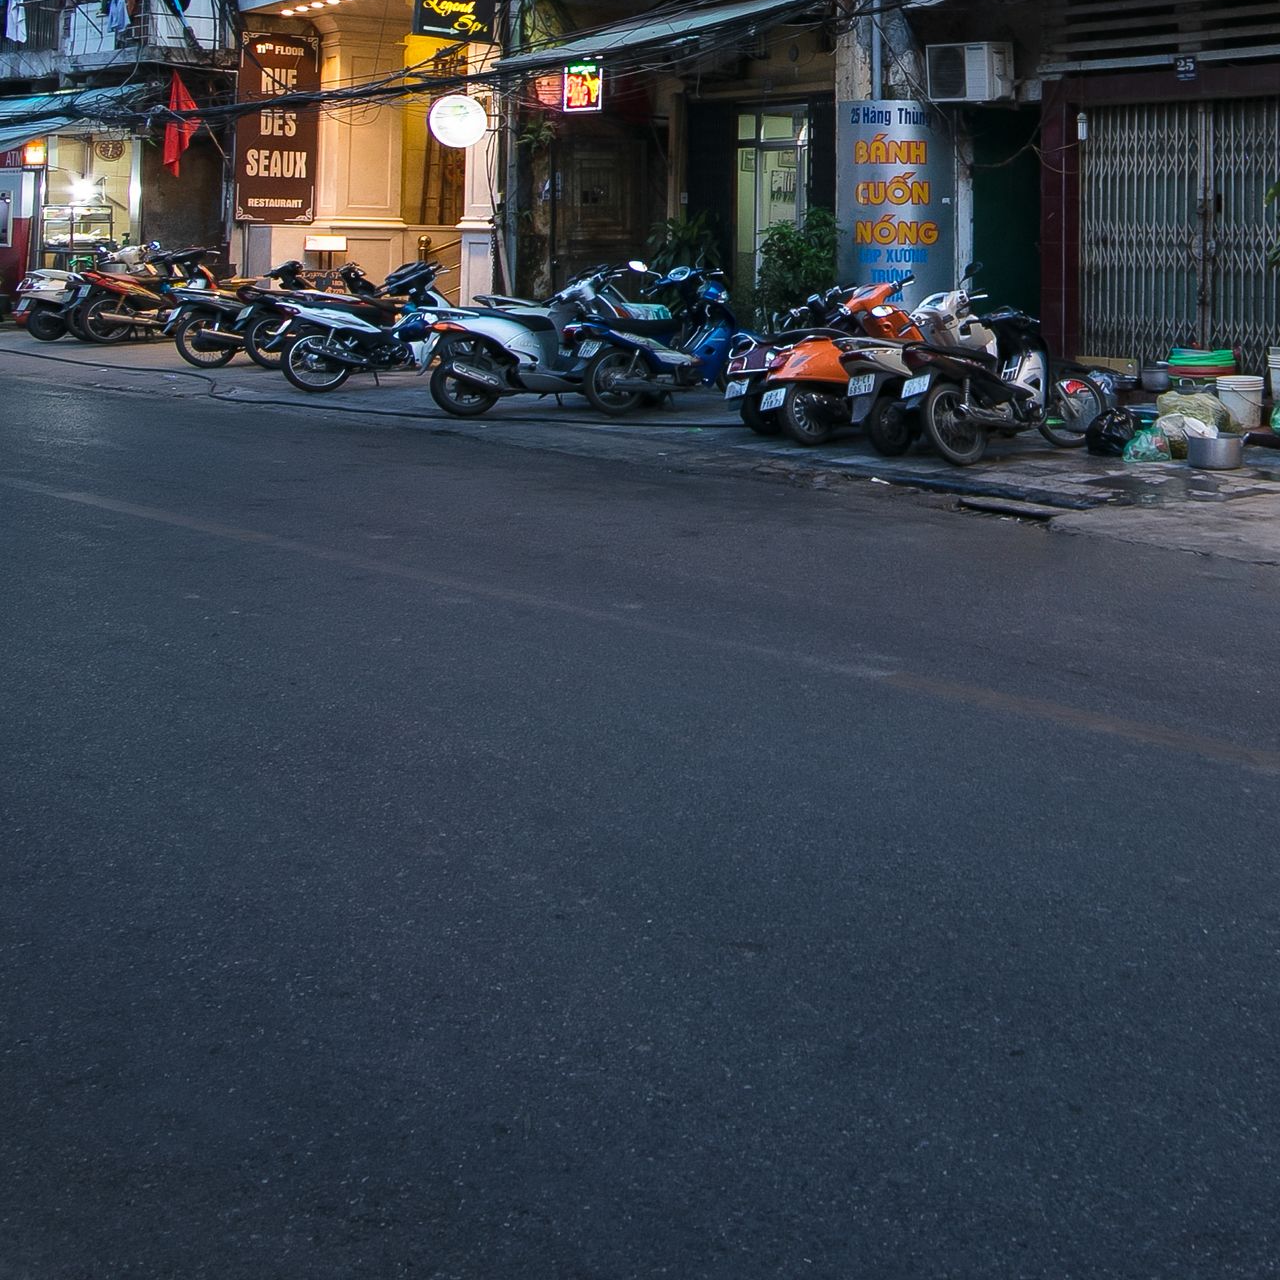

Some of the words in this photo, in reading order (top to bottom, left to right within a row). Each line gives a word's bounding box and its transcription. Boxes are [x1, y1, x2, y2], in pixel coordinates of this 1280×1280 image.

[275, 45, 305, 56] FLOOR
[1177, 58, 1194, 71] 25
[246, 148, 307, 179] SEAUX
[854, 133, 928, 165] BÁNH
[248, 197, 303, 209] RESTAURANT
[855, 172, 930, 205] CUỐN
[854, 214, 940, 246] NÓNG
